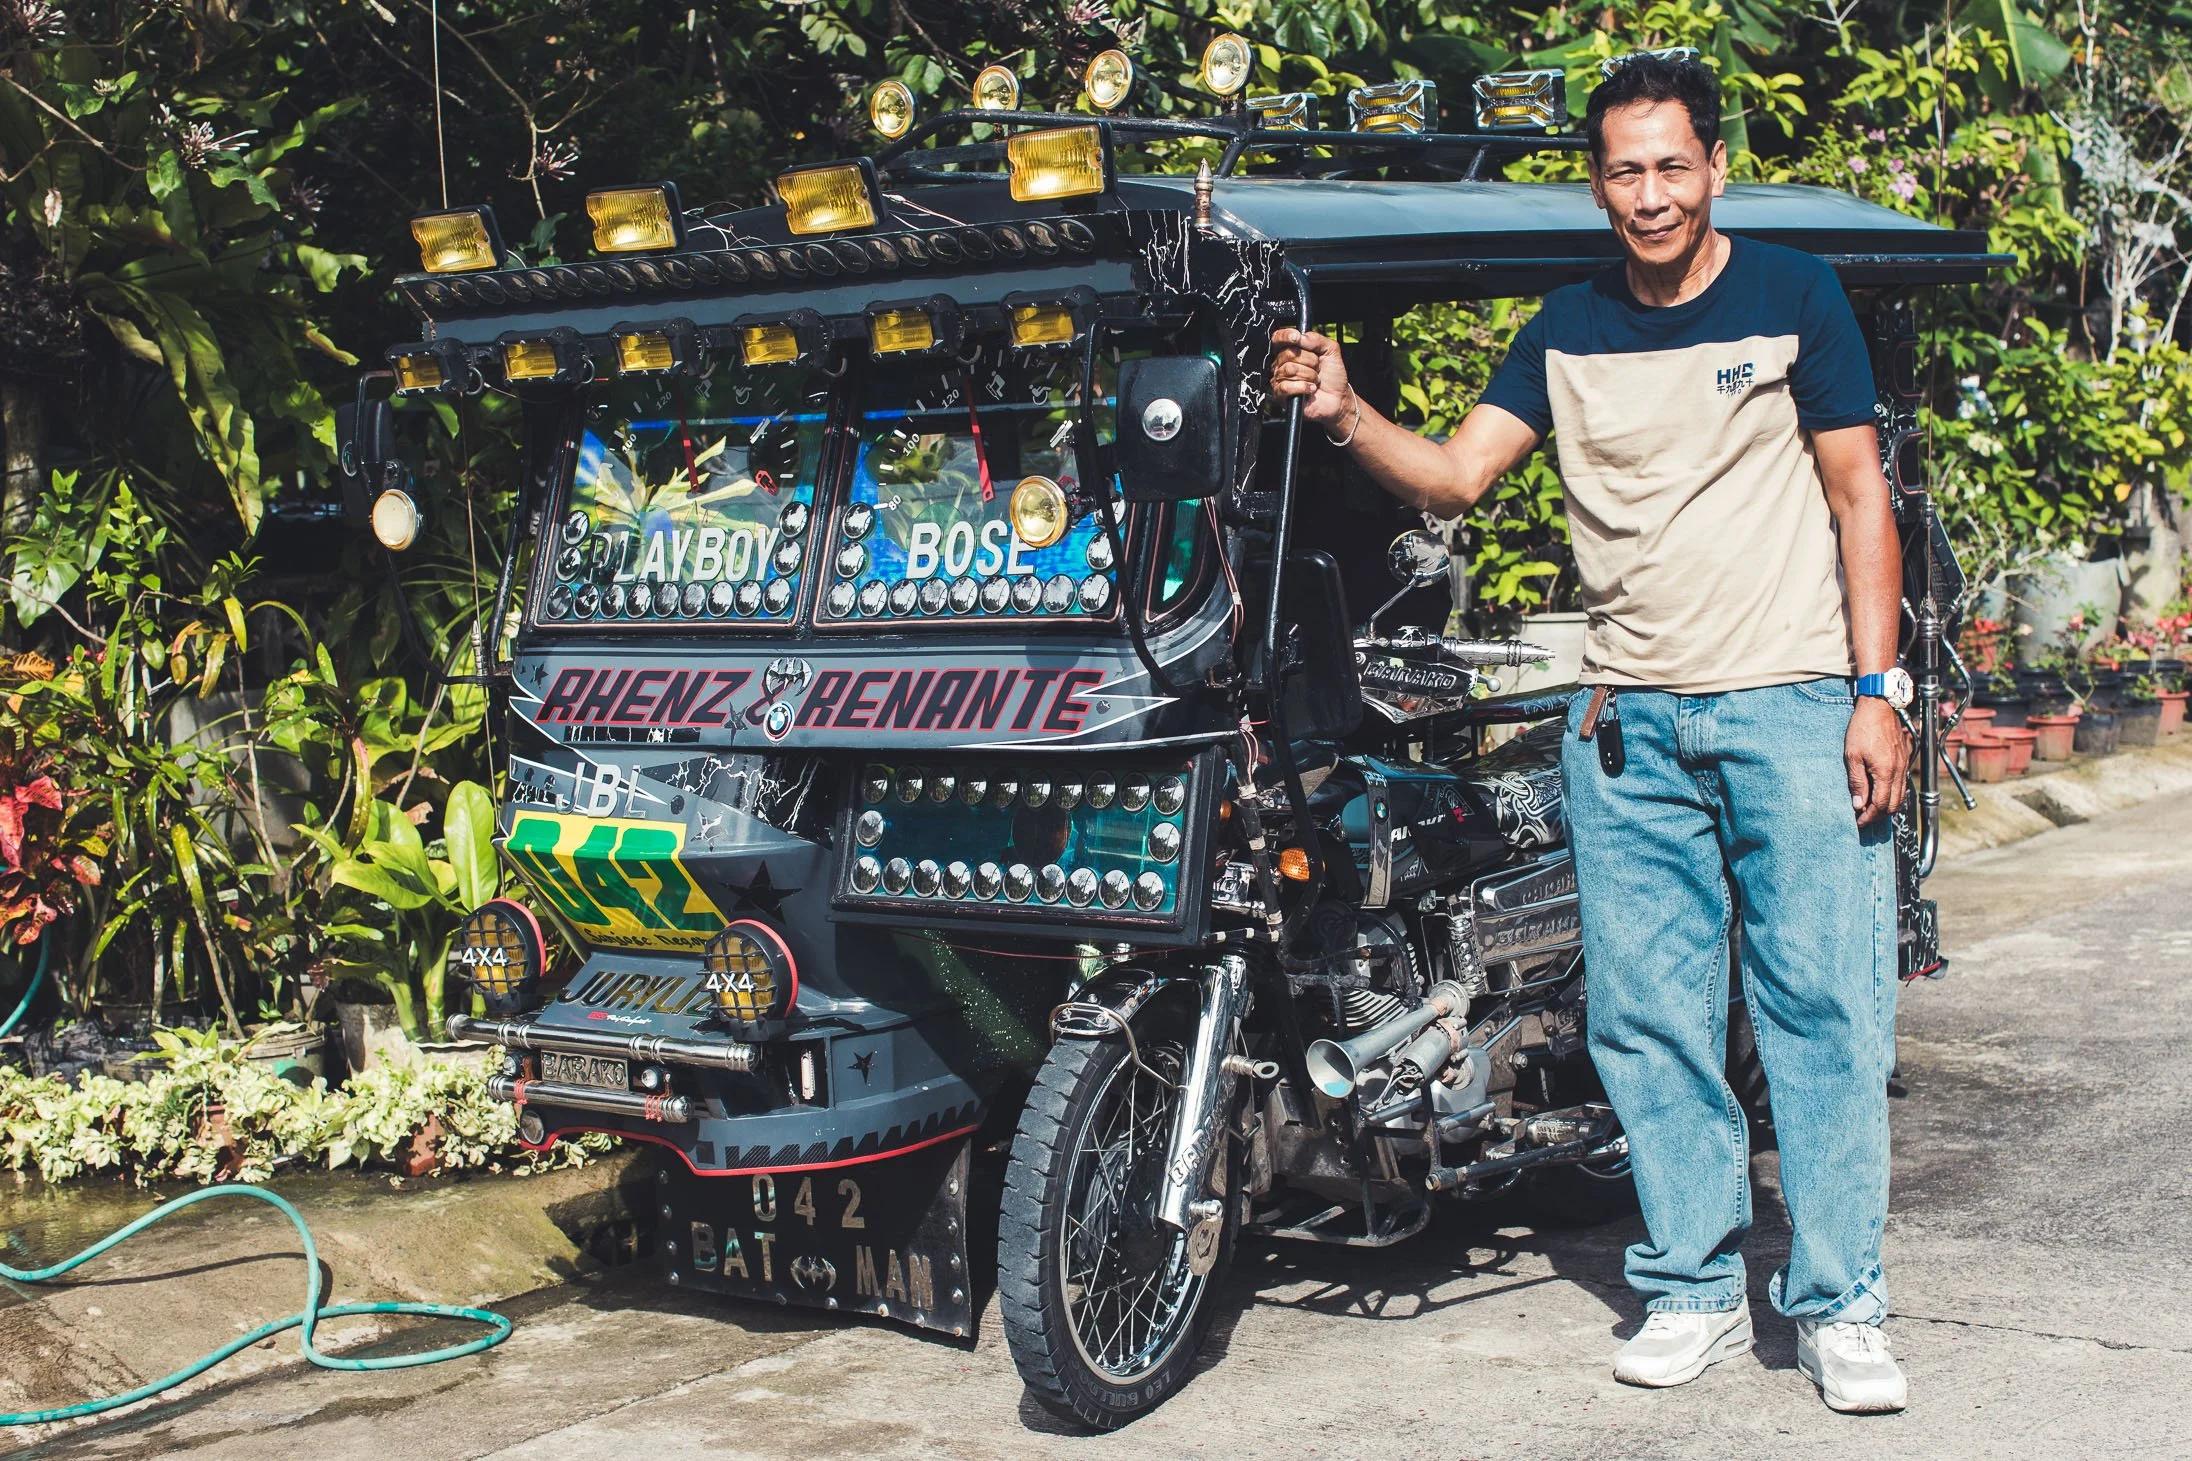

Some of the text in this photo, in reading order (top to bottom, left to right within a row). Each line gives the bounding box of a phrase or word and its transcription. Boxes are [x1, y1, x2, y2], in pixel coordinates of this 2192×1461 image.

[941, 388, 961, 410] 120
[621, 433, 637, 454] 100
[902, 433, 921, 458] 100
[888, 494, 902, 512] 80
[584, 526, 781, 584] PLAYBOY
[906, 519, 1040, 580] BOSE
[534, 667, 755, 727] RHENZ
[791, 667, 1107, 734] RENANTE
[554, 761, 647, 819] JBL
[506, 818, 726, 931] 042
[461, 947, 508, 967] 4X4
[704, 972, 756, 994] 4X4
[541, 1051, 627, 1086] BARAKO
[752, 1173, 865, 1229] 042
[690, 1220, 934, 1311] BAT MAN
